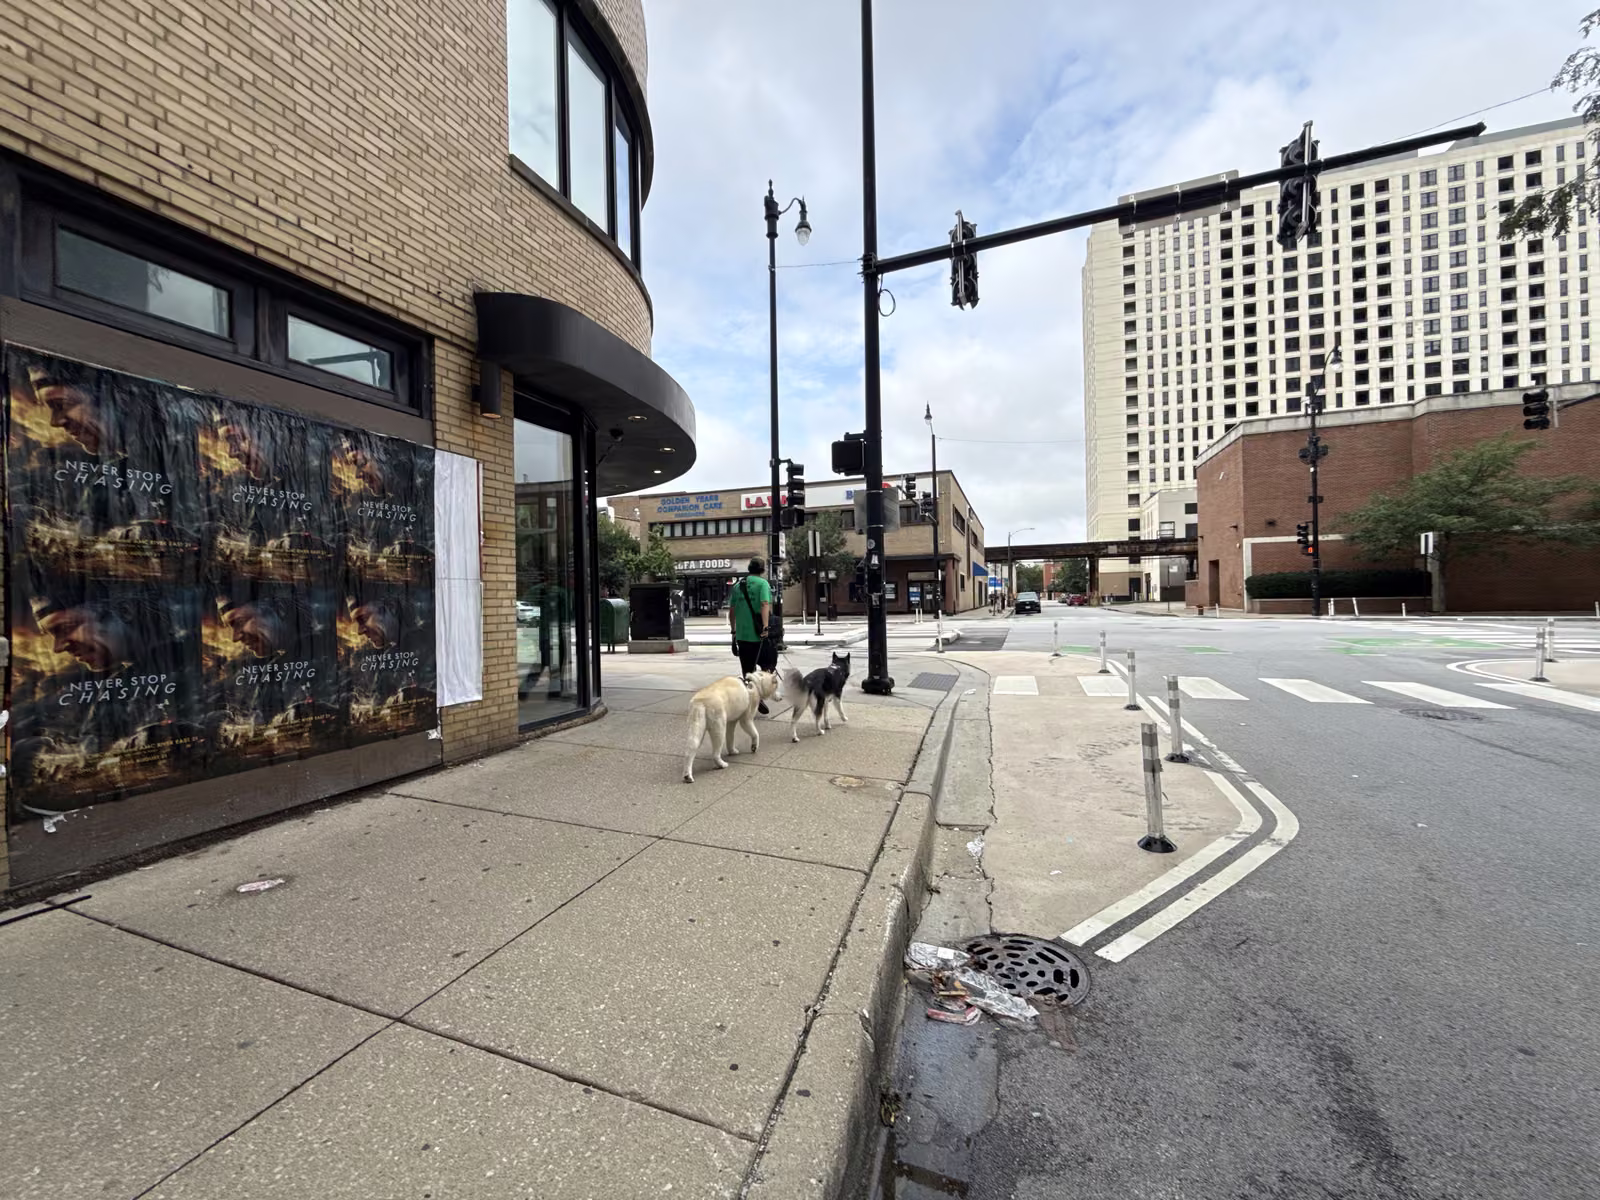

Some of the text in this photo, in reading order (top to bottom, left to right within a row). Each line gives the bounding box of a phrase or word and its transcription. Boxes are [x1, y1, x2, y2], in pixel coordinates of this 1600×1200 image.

[66, 460, 162, 482] NEVER STOP
[54, 469, 173, 495] CHASING
[239, 484, 305, 500] NEVER STOP
[232, 492, 313, 511] CHASING
[363, 501, 412, 513] NEVER STOP
[657, 501, 723, 513] COMPANION CARE
[661, 495, 719, 506] GOLDEN YEARS
[357, 507, 417, 522] CHASING
[699, 559, 731, 569] FOODS
[365, 651, 415, 662] NEVER STOP
[242, 661, 309, 674] NEVER STOP
[360, 657, 419, 672] CHASING
[70, 674, 167, 692] NEVER STOP
[235, 668, 316, 686] CHASING
[59, 682, 176, 706] CHASING
